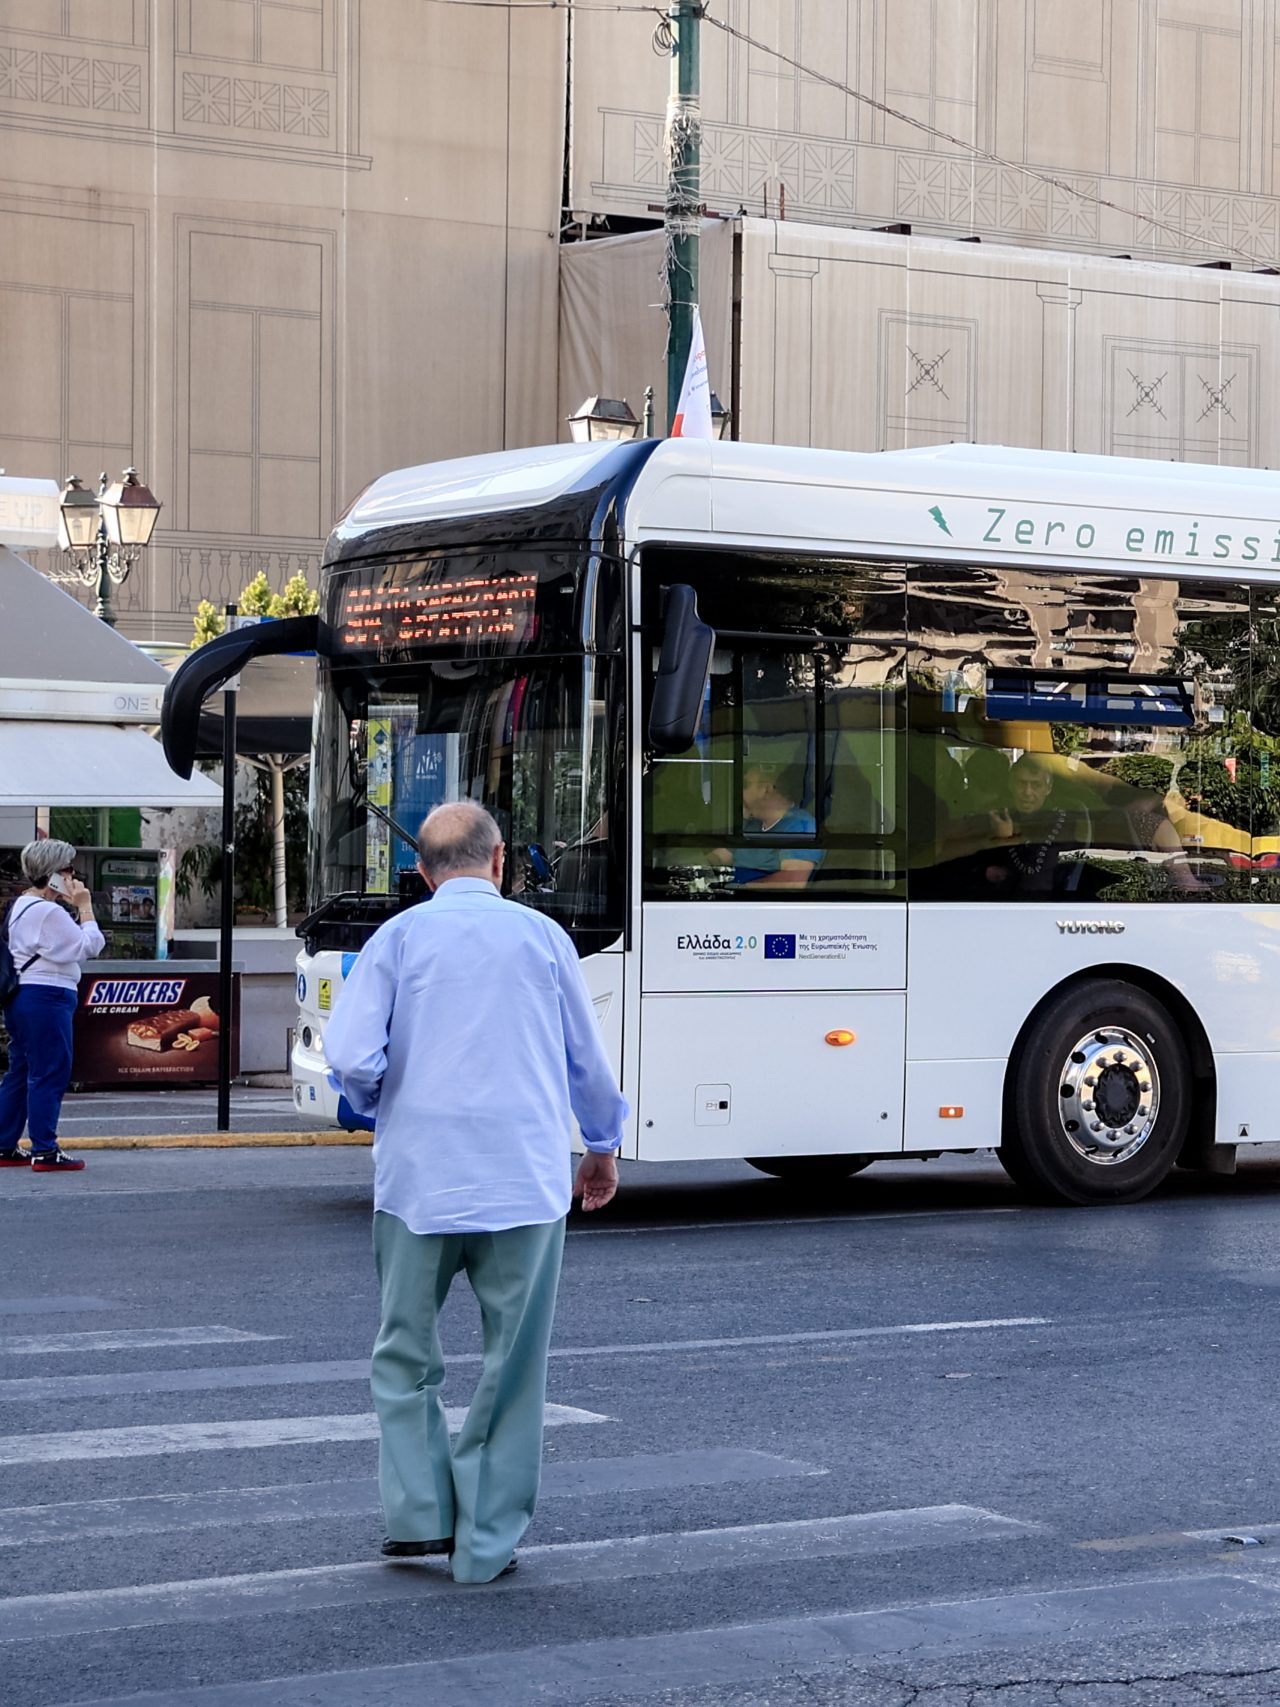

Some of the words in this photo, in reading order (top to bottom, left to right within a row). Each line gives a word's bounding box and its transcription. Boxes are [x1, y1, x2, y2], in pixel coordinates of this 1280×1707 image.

[983, 508, 1096, 549] Zero
[114, 696, 149, 710] ONE
[1056, 920, 1125, 934] YUTONG
[677, 934, 731, 949] Ελλάδα
[735, 936, 757, 949] 2.0
[90, 981, 183, 1003] SNICKERS
[93, 1006, 108, 1014] ICE
